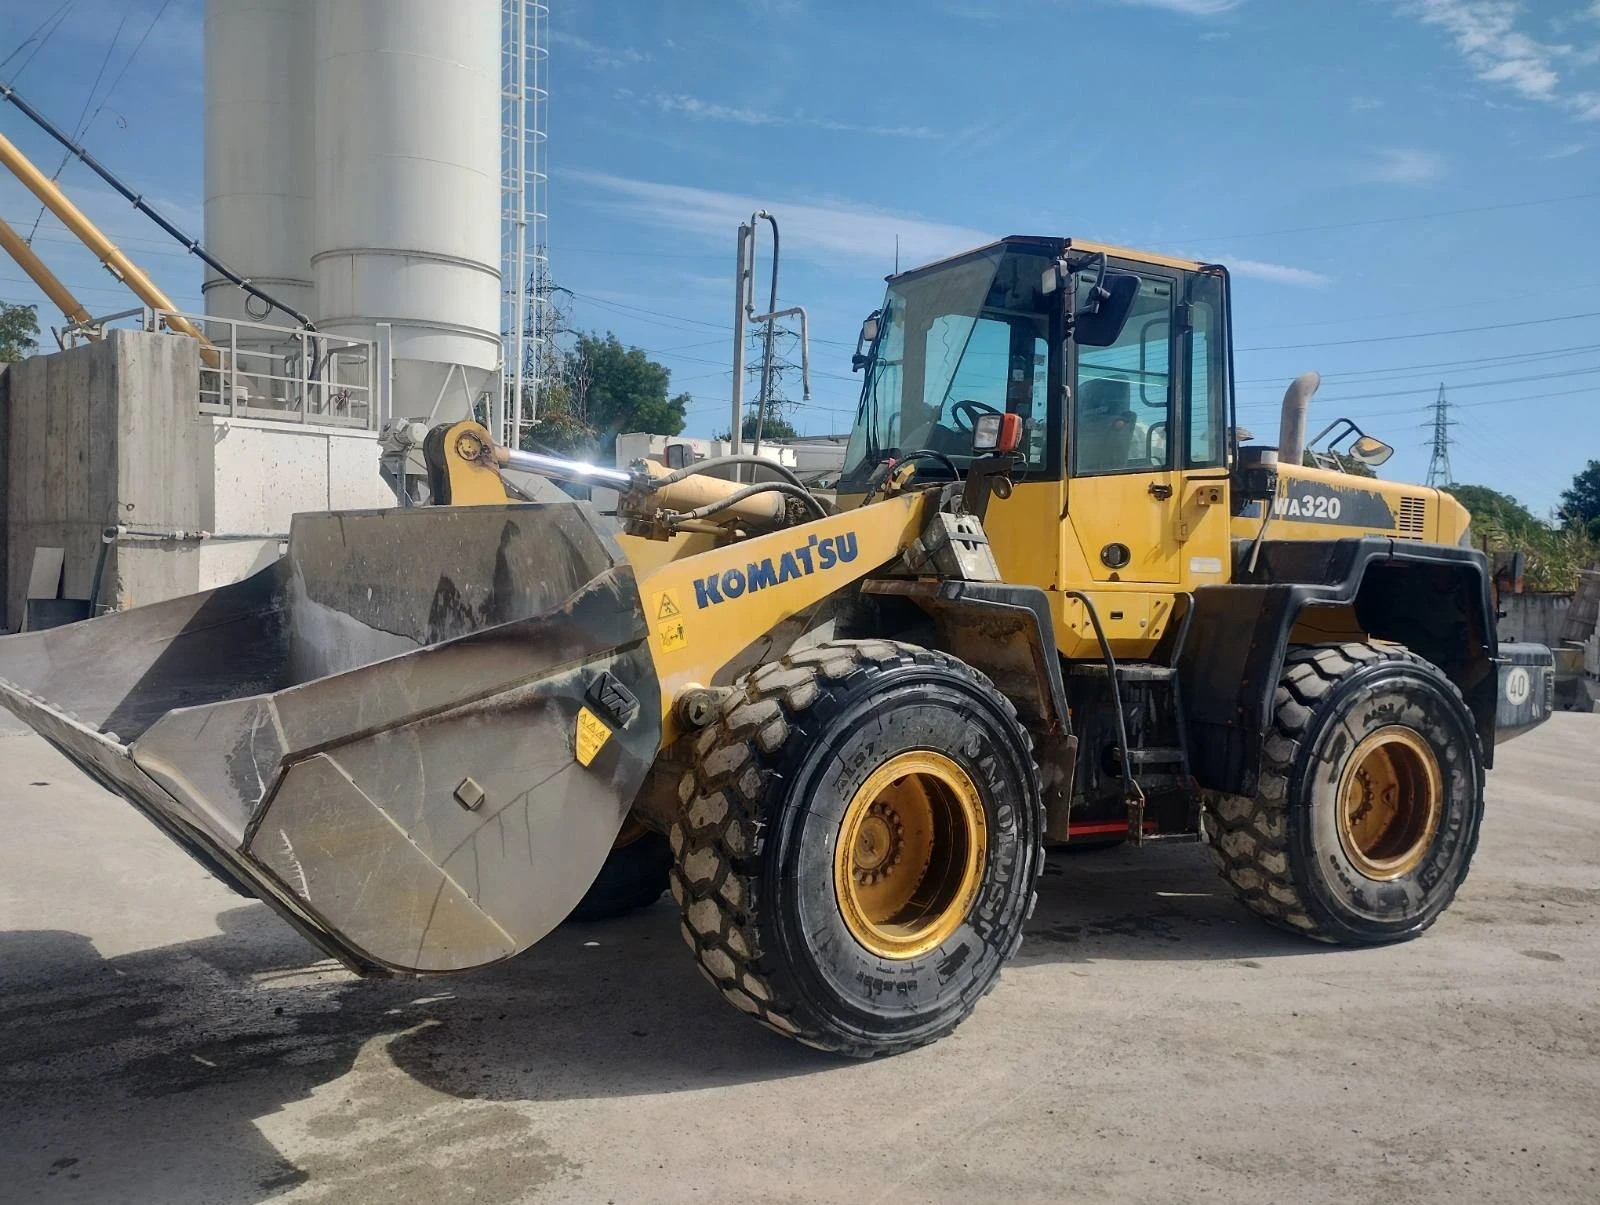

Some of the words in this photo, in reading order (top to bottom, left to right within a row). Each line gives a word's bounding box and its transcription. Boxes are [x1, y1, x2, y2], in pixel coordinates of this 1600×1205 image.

[1274, 495, 1341, 519] WA320
[693, 531, 858, 609] KOMATSU
[1510, 675, 1525, 696] 40
